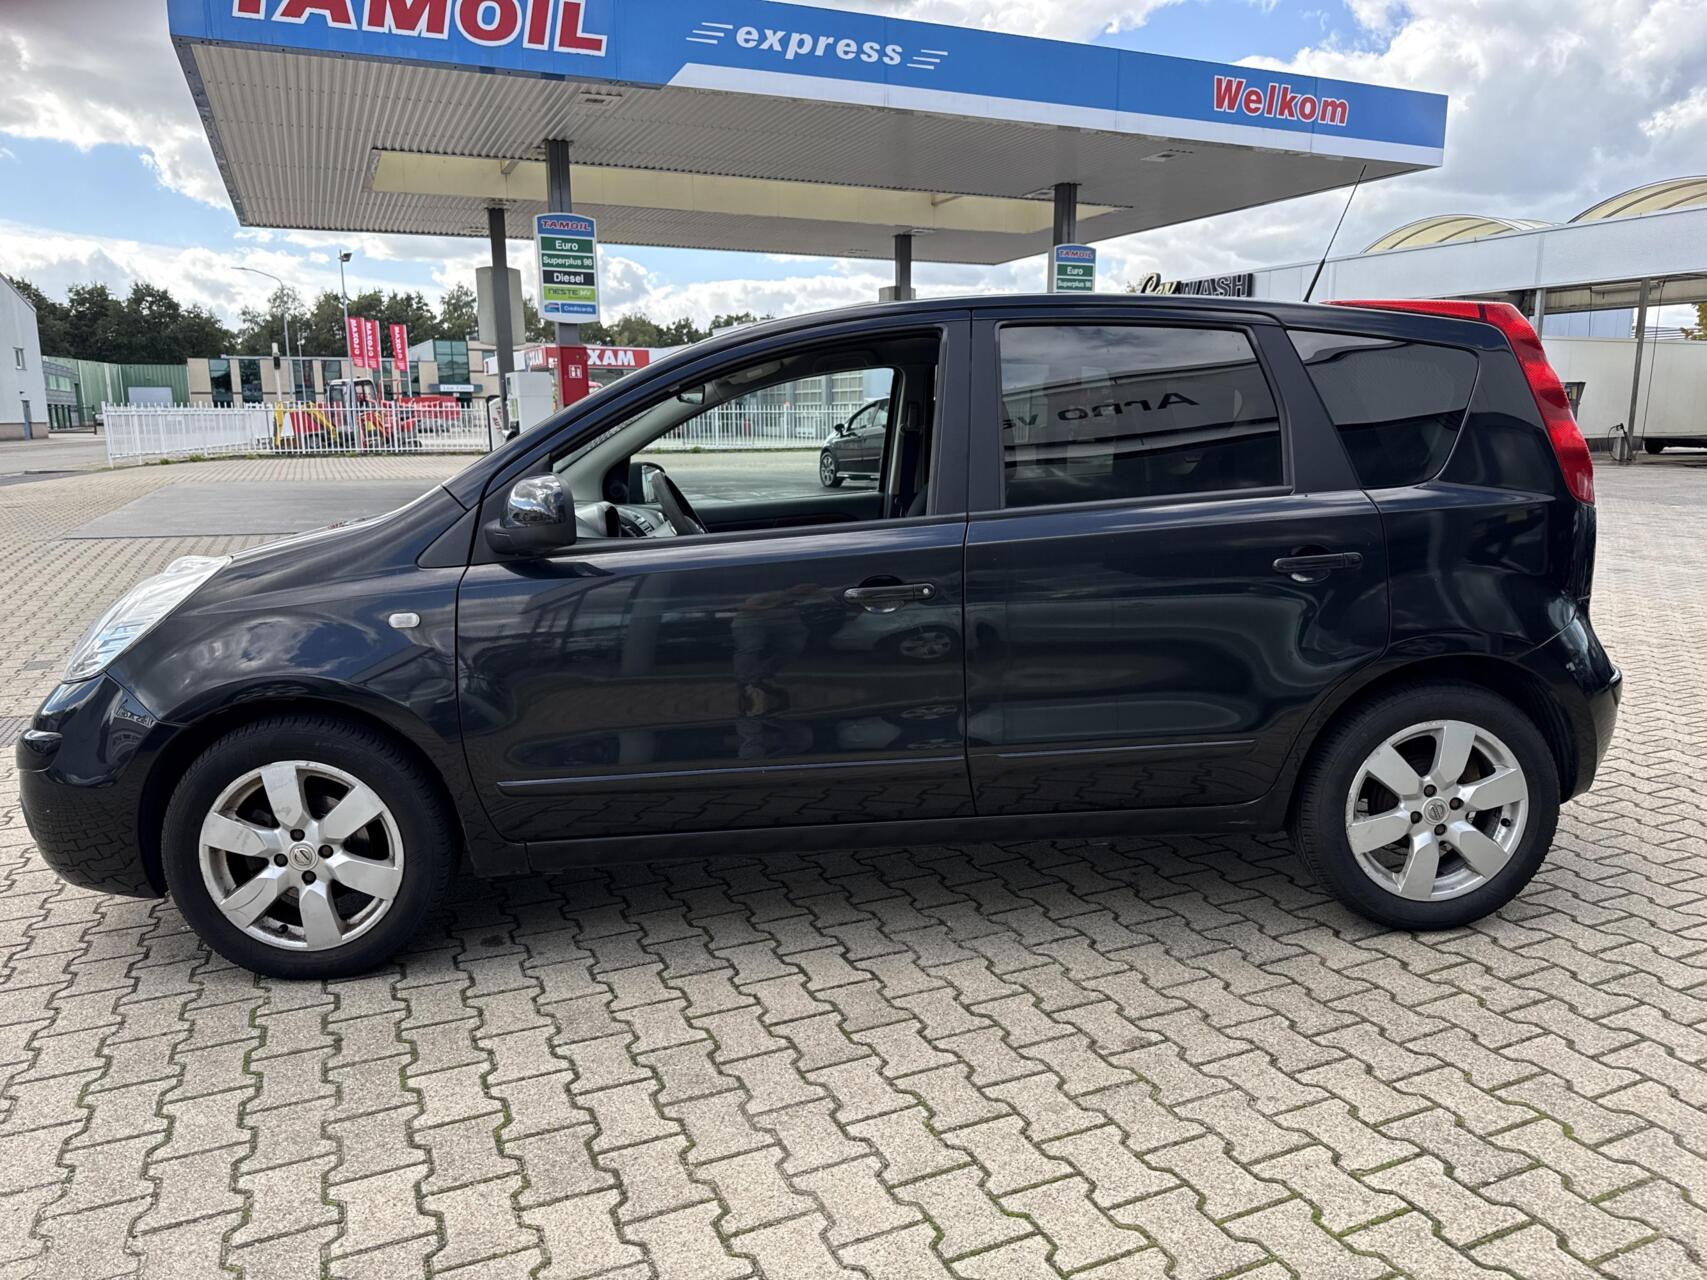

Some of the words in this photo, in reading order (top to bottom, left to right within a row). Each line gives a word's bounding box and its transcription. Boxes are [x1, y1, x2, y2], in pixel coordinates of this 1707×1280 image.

[736, 25, 903, 65] express
[1214, 75, 1349, 126] Welkom
[542, 220, 591, 232] TAMOIL
[556, 240, 578, 250] Euro
[1059, 250, 1093, 259] TAMOIL
[543, 256, 582, 266] Superplus
[583, 258, 593, 266] 98
[1067, 266, 1083, 275] Euro
[553, 272, 584, 283] Diesel
[587, 350, 635, 366] XAM
